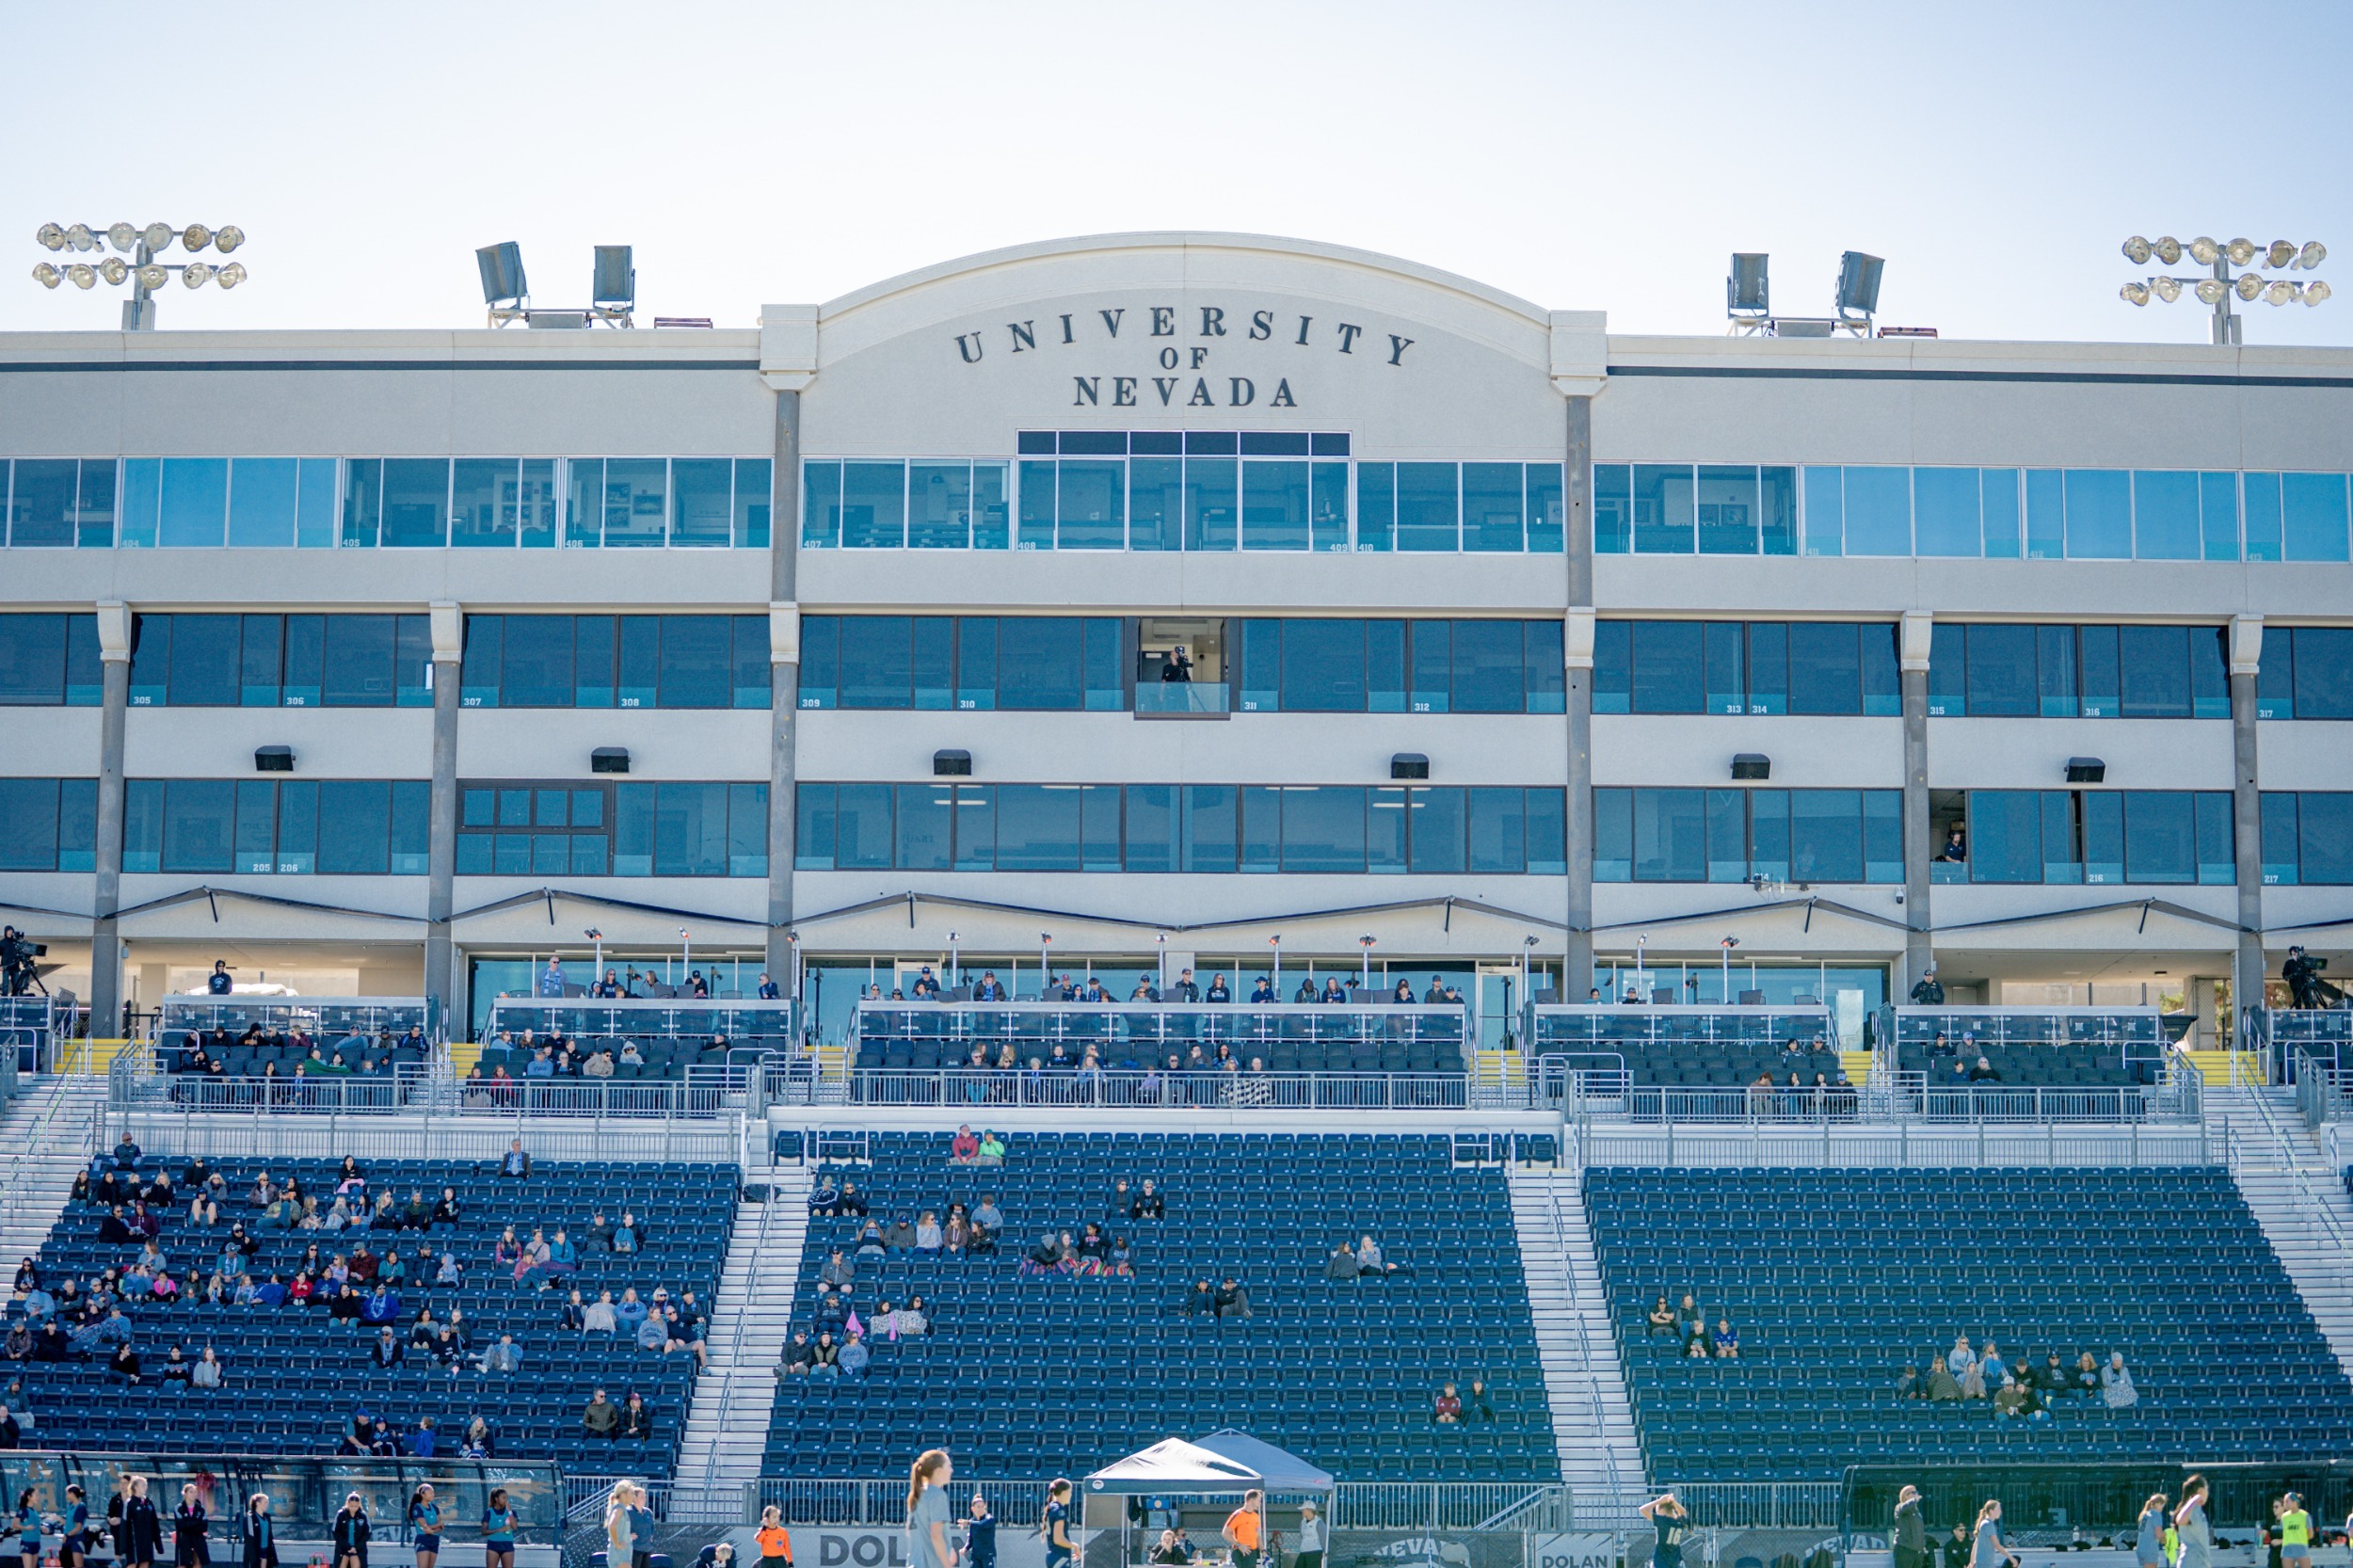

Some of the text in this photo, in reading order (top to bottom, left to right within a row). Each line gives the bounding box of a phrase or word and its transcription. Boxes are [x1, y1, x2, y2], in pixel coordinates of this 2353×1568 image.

[954, 307, 1415, 367] UNIVERSITY
[1160, 346, 1209, 370] OF
[1073, 376, 1298, 407] NEVADA
[343, 538, 360, 547] 405
[566, 539, 584, 548] 406
[1017, 541, 1036, 550] 408
[1330, 543, 1348, 552] 409
[1358, 543, 1374, 552] 410
[134, 696, 151, 704] 305
[286, 696, 304, 705] 306
[464, 697, 481, 706] 307
[621, 698, 639, 707] 308
[802, 698, 820, 707] 309
[960, 700, 975, 709] 310
[1244, 701, 1257, 710] 311
[1415, 702, 1430, 712] 312
[1726, 705, 1741, 713] 313
[1752, 705, 1768, 713] 314
[1929, 706, 1945, 715] 315
[2085, 708, 2100, 716] 316
[2259, 710, 2273, 718] 317
[252, 863, 270, 872] 205
[280, 864, 298, 872] 206
[2089, 874, 2104, 883] 216
[2264, 874, 2279, 884] 217
[1666, 1527, 1683, 1545] 16
[1542, 1555, 1609, 1568] DOLAN
